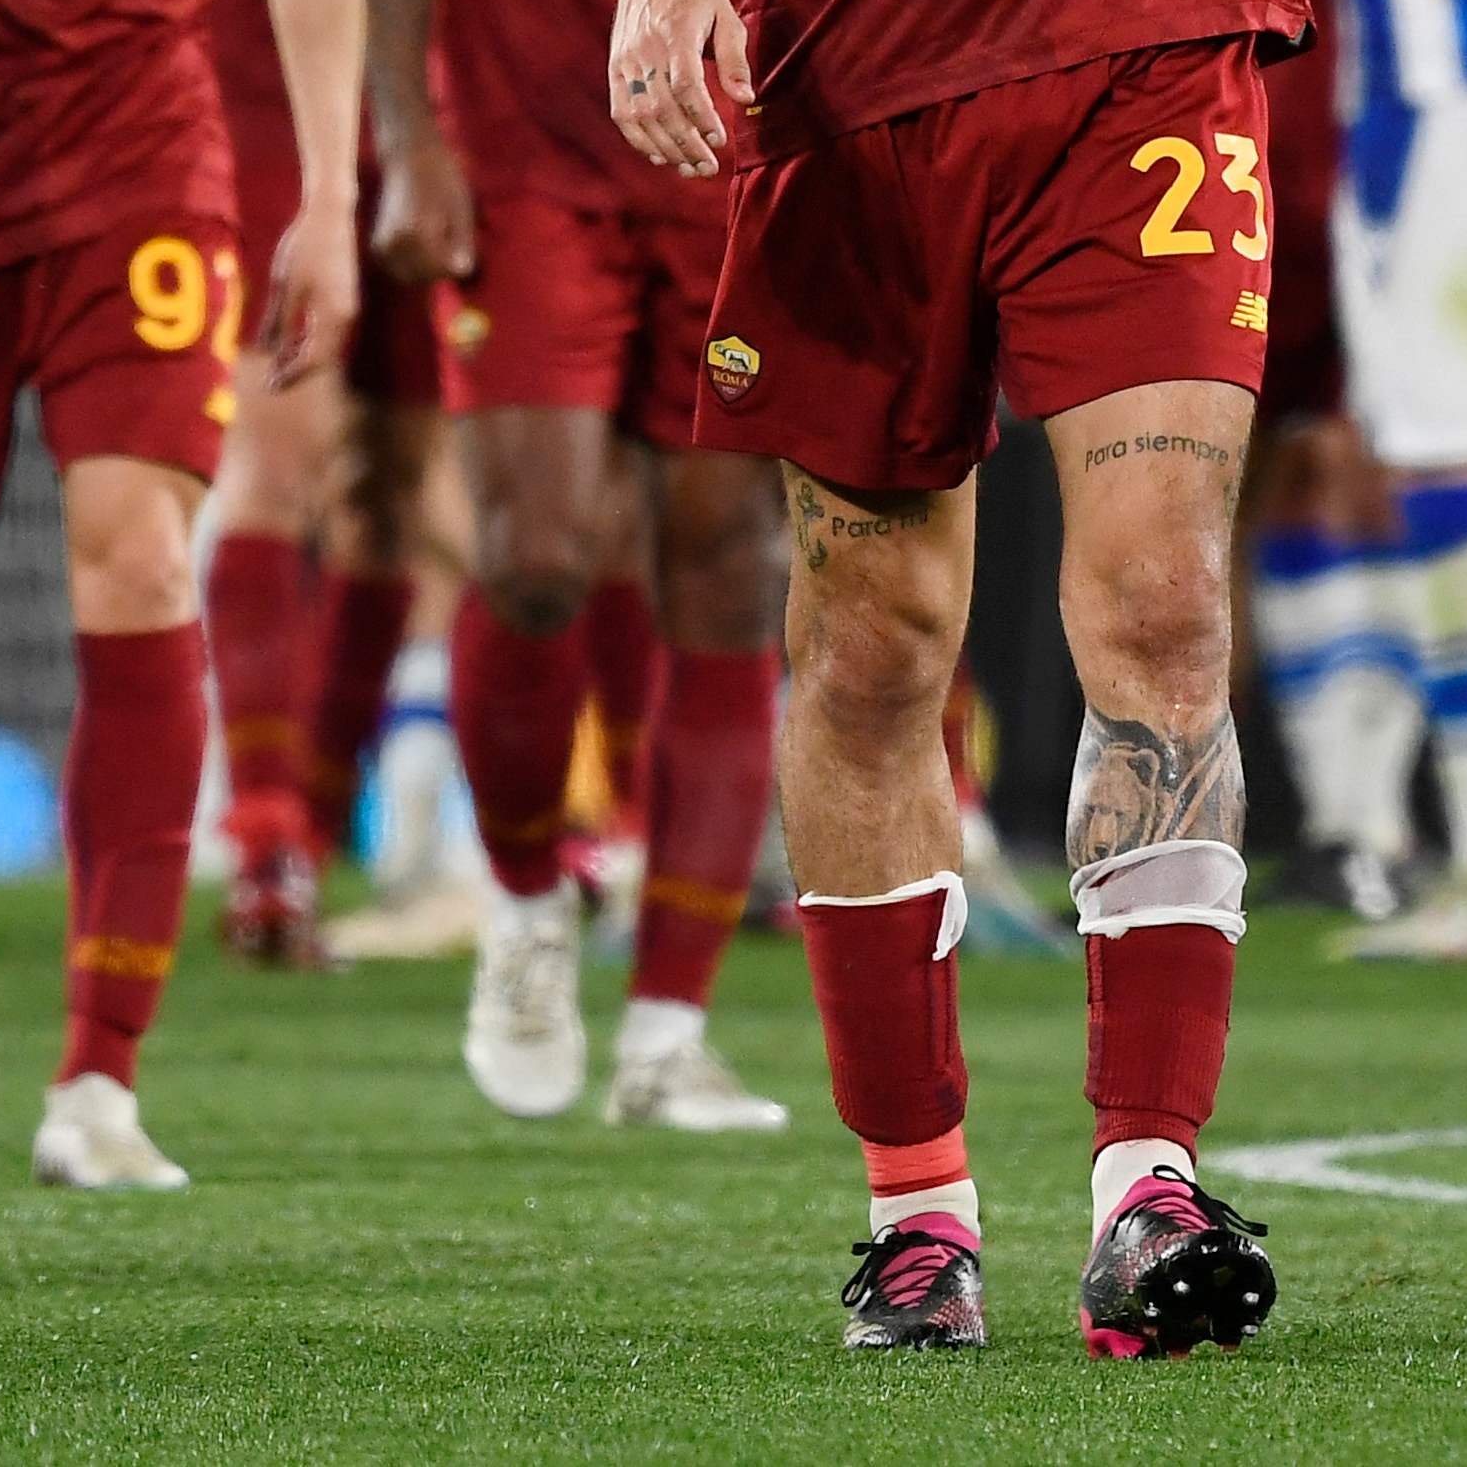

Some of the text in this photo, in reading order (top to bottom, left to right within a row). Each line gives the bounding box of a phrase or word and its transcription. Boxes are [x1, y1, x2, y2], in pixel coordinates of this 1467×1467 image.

[1129, 132, 1268, 262] 23
[1134, 431, 1229, 467] siempre
[832, 516, 892, 538] Para
